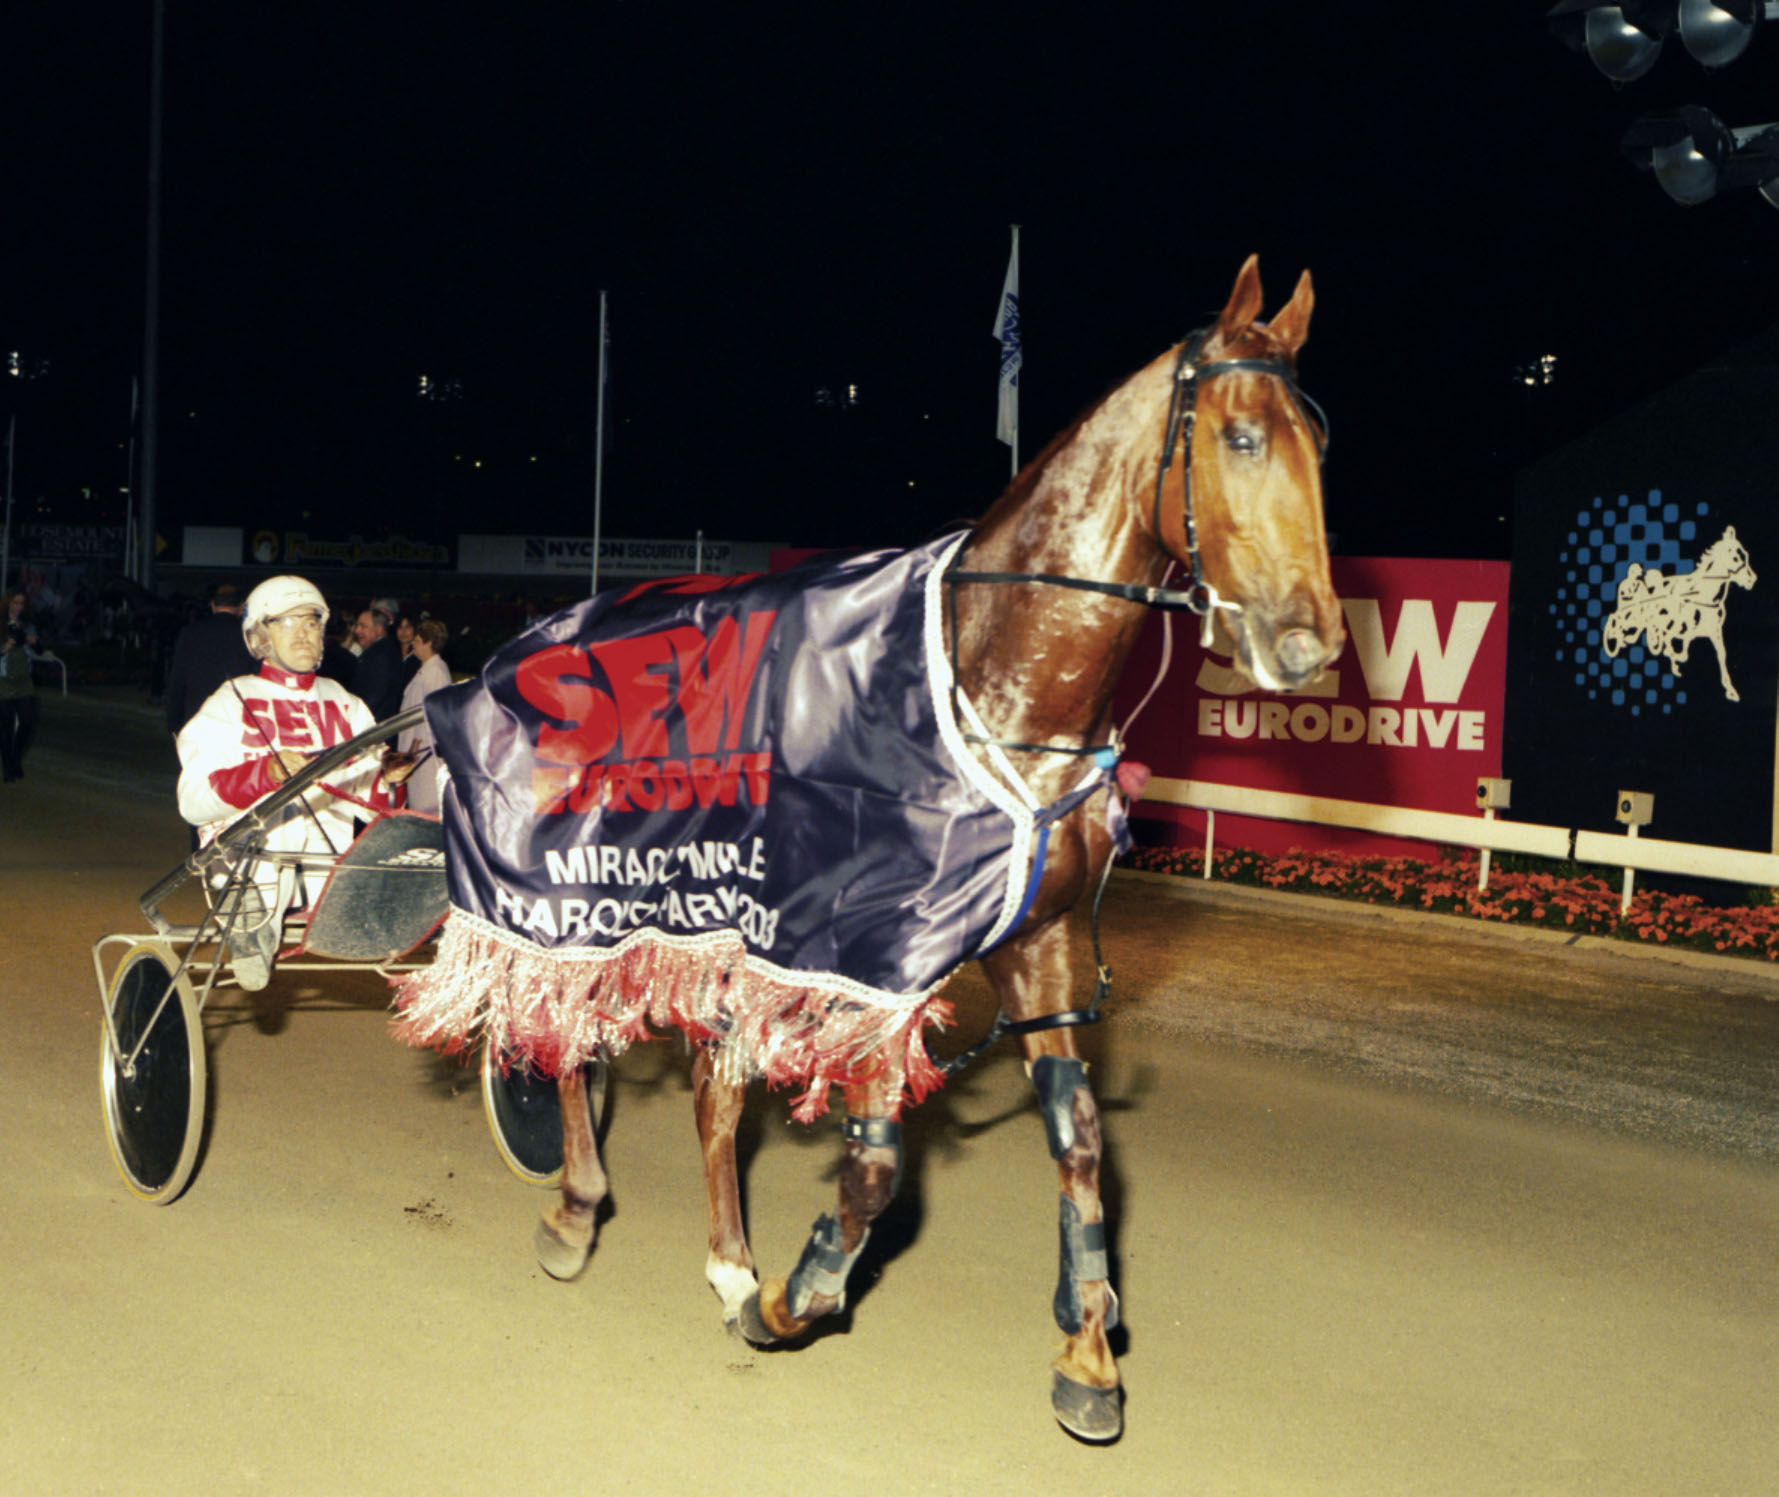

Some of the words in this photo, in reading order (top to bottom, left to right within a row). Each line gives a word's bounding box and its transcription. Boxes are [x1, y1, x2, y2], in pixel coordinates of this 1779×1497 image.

[548, 541, 624, 557] NYCON
[628, 543, 686, 558] SECURITY
[687, 544, 731, 560] GOUP
[241, 698, 354, 749] SEW
[1198, 698, 1486, 752] EURODRIVE
[545, 844, 691, 886] MIRACL
